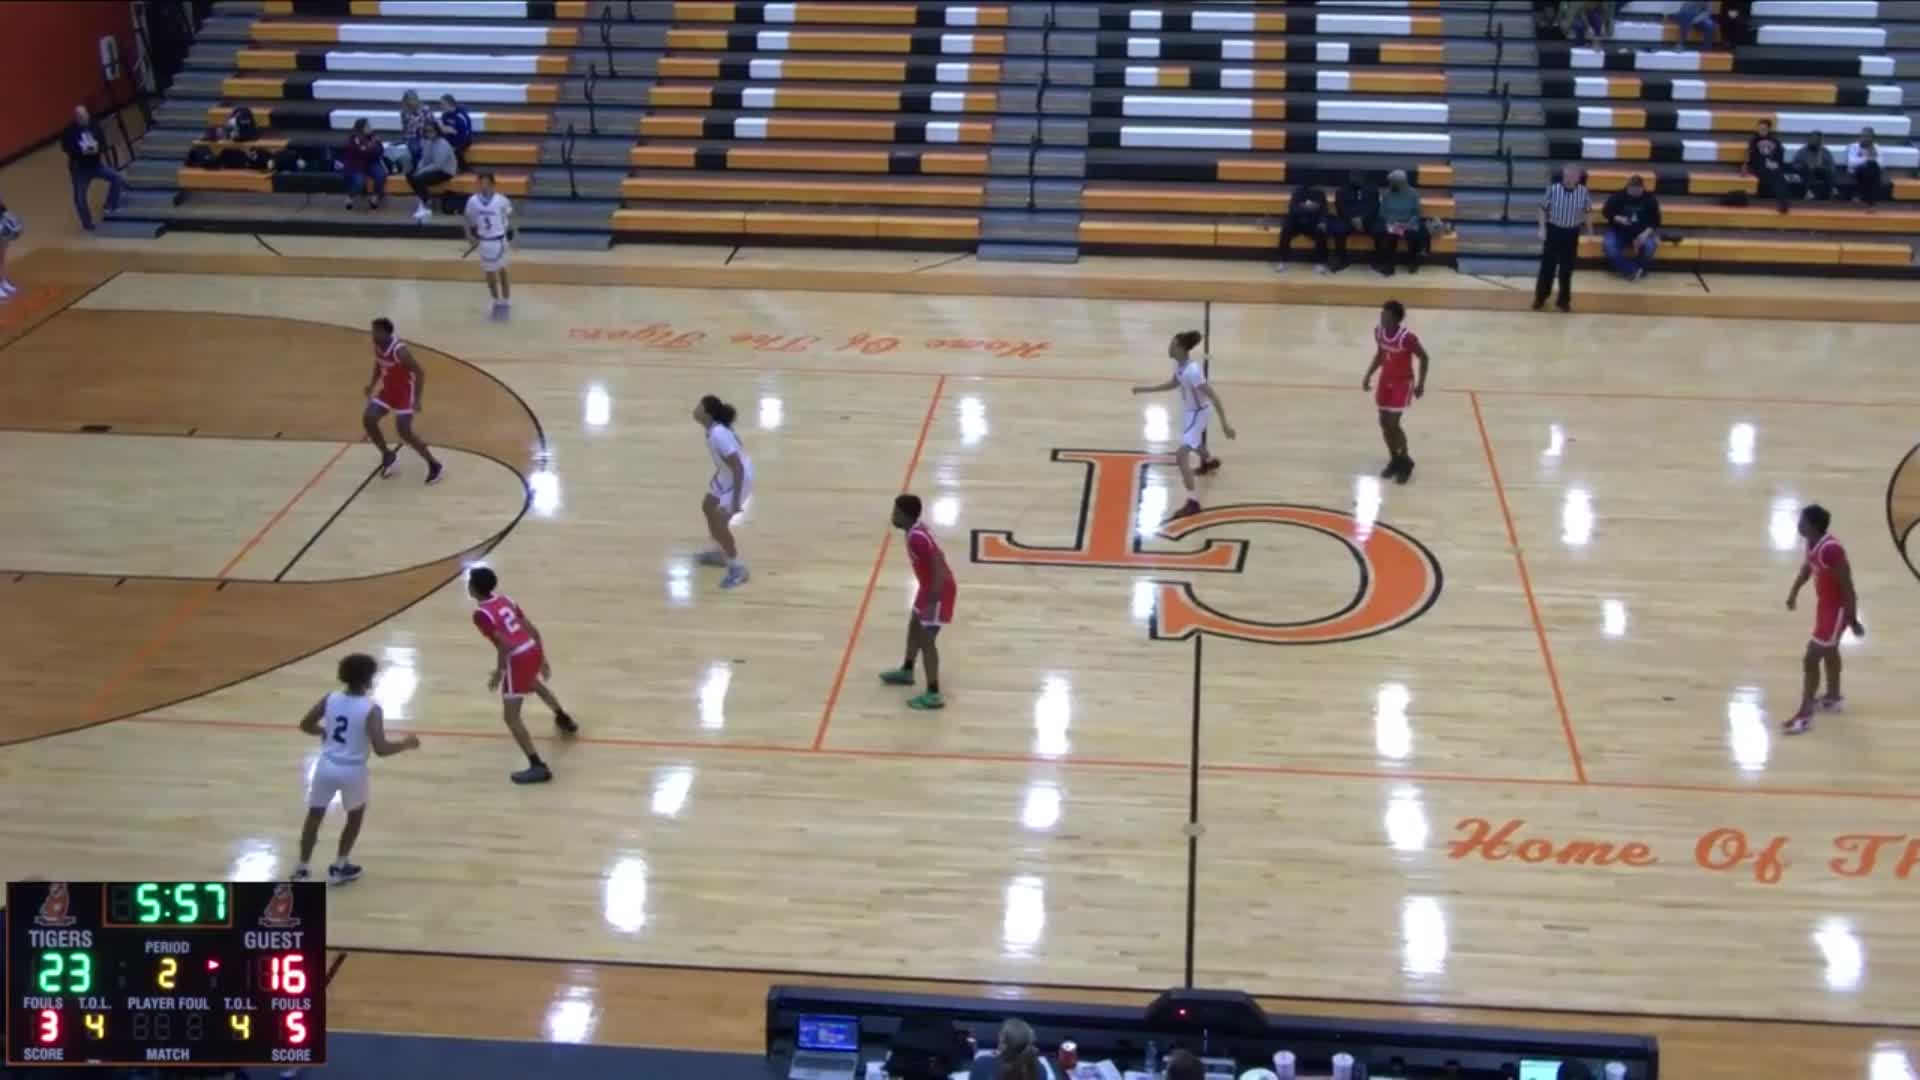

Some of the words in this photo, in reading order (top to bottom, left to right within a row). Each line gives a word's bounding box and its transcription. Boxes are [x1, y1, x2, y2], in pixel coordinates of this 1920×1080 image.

[499, 606, 521, 633] 2
[332, 715, 349, 745] 2
[1446, 817, 1658, 868] Home
[1694, 827, 1791, 884] Of
